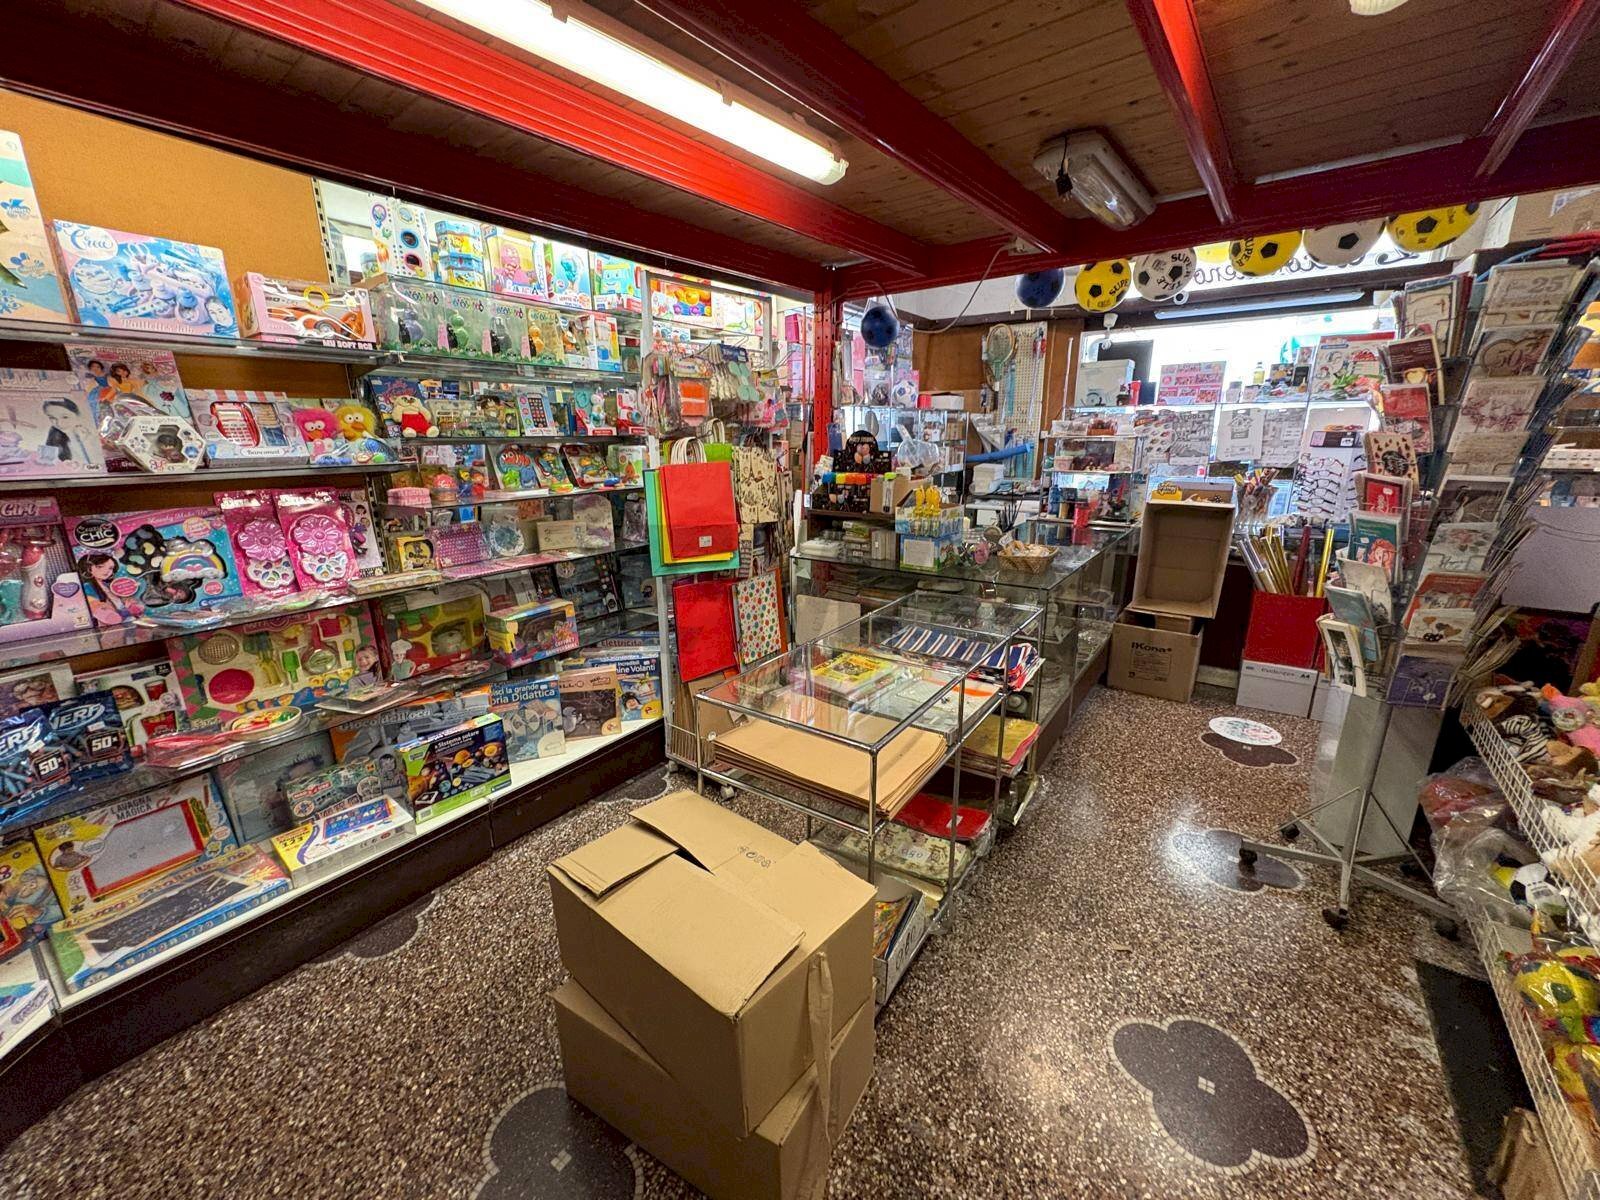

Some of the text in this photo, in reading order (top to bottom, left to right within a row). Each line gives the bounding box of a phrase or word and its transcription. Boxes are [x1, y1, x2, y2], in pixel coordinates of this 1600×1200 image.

[1236, 238, 1254, 266] UPER
[1171, 253, 1192, 277] SUPER
[1109, 279, 1129, 296] SUPE
[1157, 276, 1182, 291] TELE
[80, 529, 114, 542] CHIC
[630, 664, 656, 673] Volanti
[511, 688, 555, 702] Didattica
[514, 683, 539, 693] grande
[50, 704, 102, 730] NERF
[0, 722, 42, 751] ERF
[110, 795, 153, 815] LAVAGNA
[116, 803, 153, 820] MAGICA
